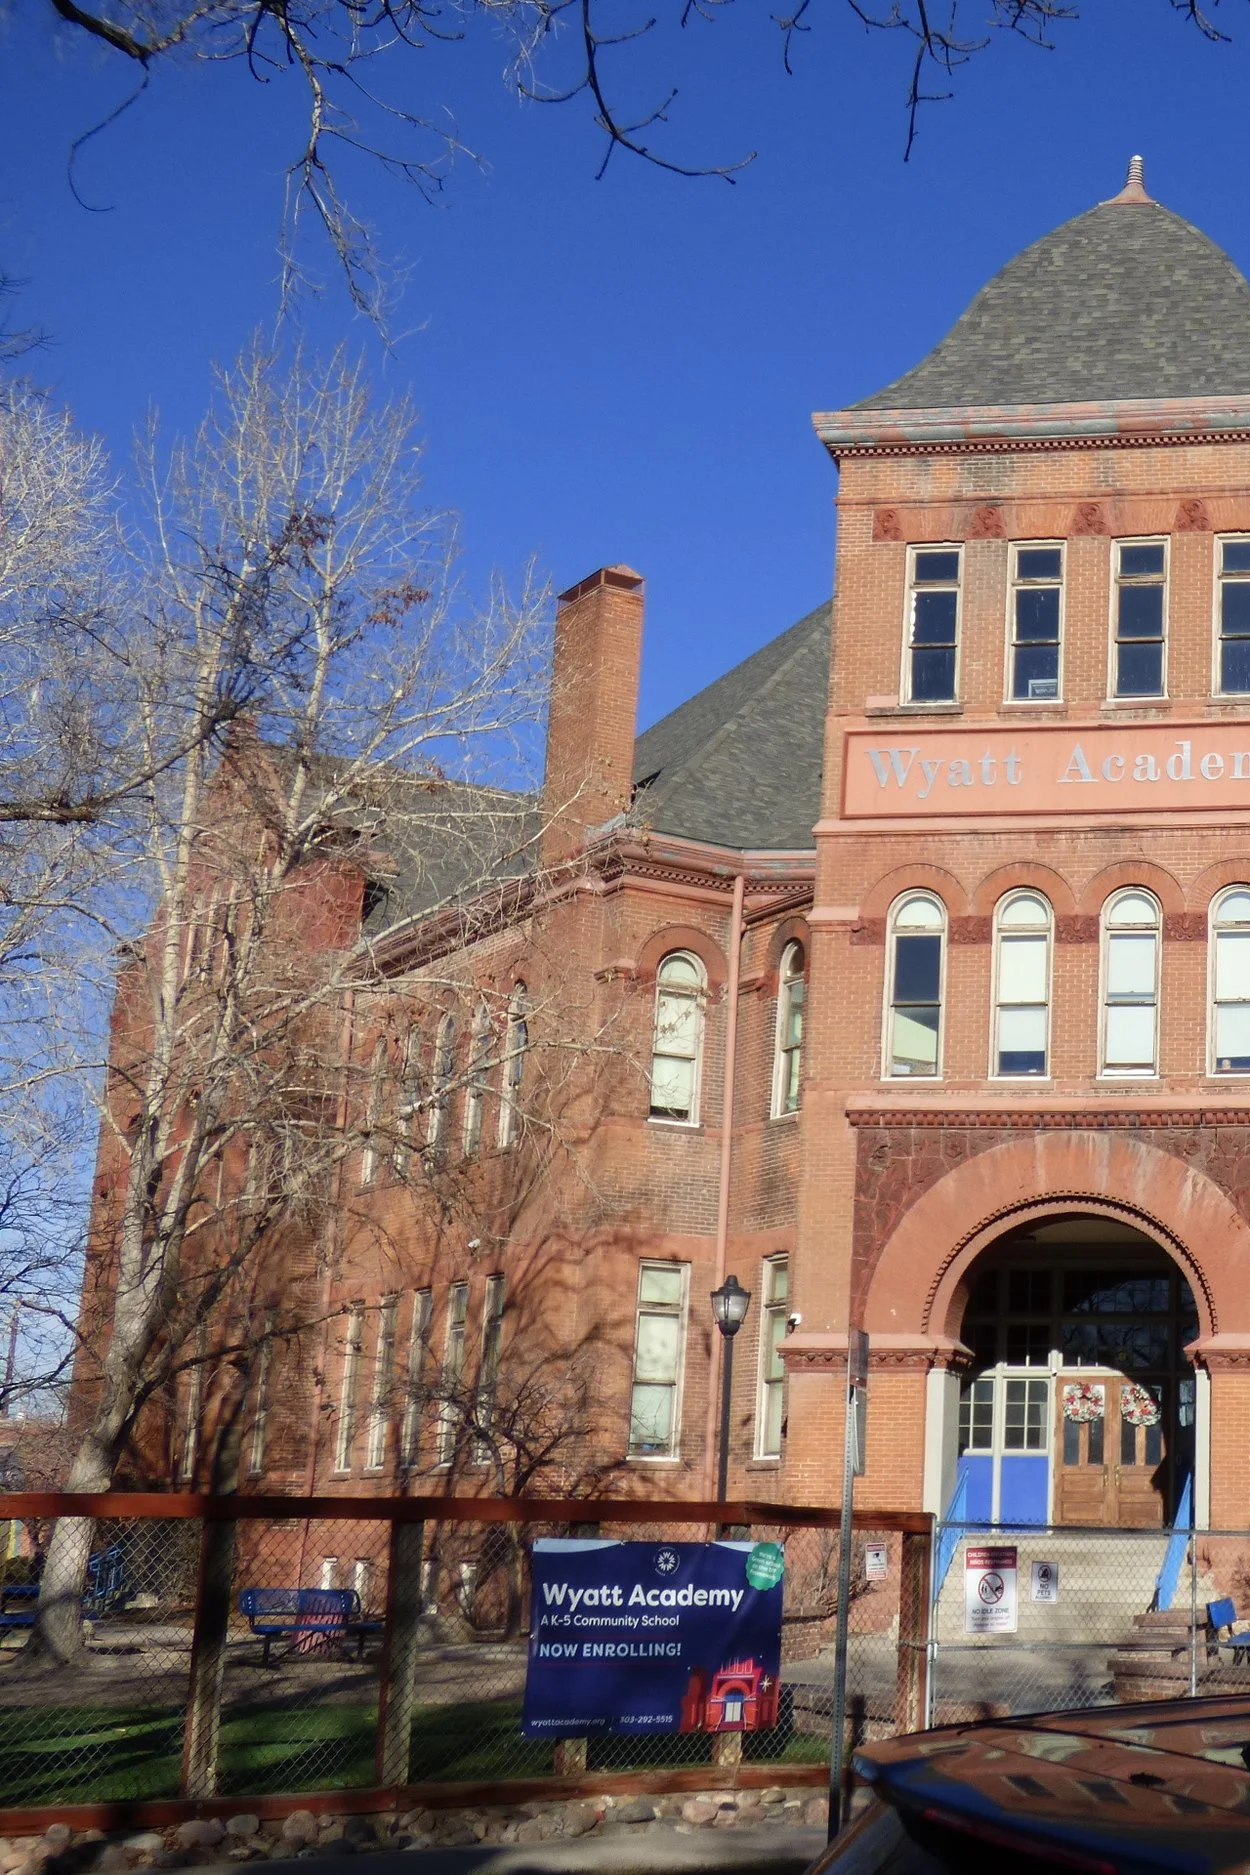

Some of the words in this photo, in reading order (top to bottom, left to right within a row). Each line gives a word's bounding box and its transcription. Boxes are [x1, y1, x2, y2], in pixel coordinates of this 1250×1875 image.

[865, 747, 1024, 799] Wyatt
[542, 1583, 623, 1611] Wyatt
[628, 1584, 744, 1611] Academy
[540, 1615, 549, 1626] A
[551, 1615, 571, 1626] K-5
[573, 1615, 639, 1628] Community
[641, 1615, 680, 1626] School
[540, 1643, 578, 1657] NOW
[583, 1643, 681, 1657] ENROLLING!
[531, 1717, 605, 1728] wyattacademy.org
